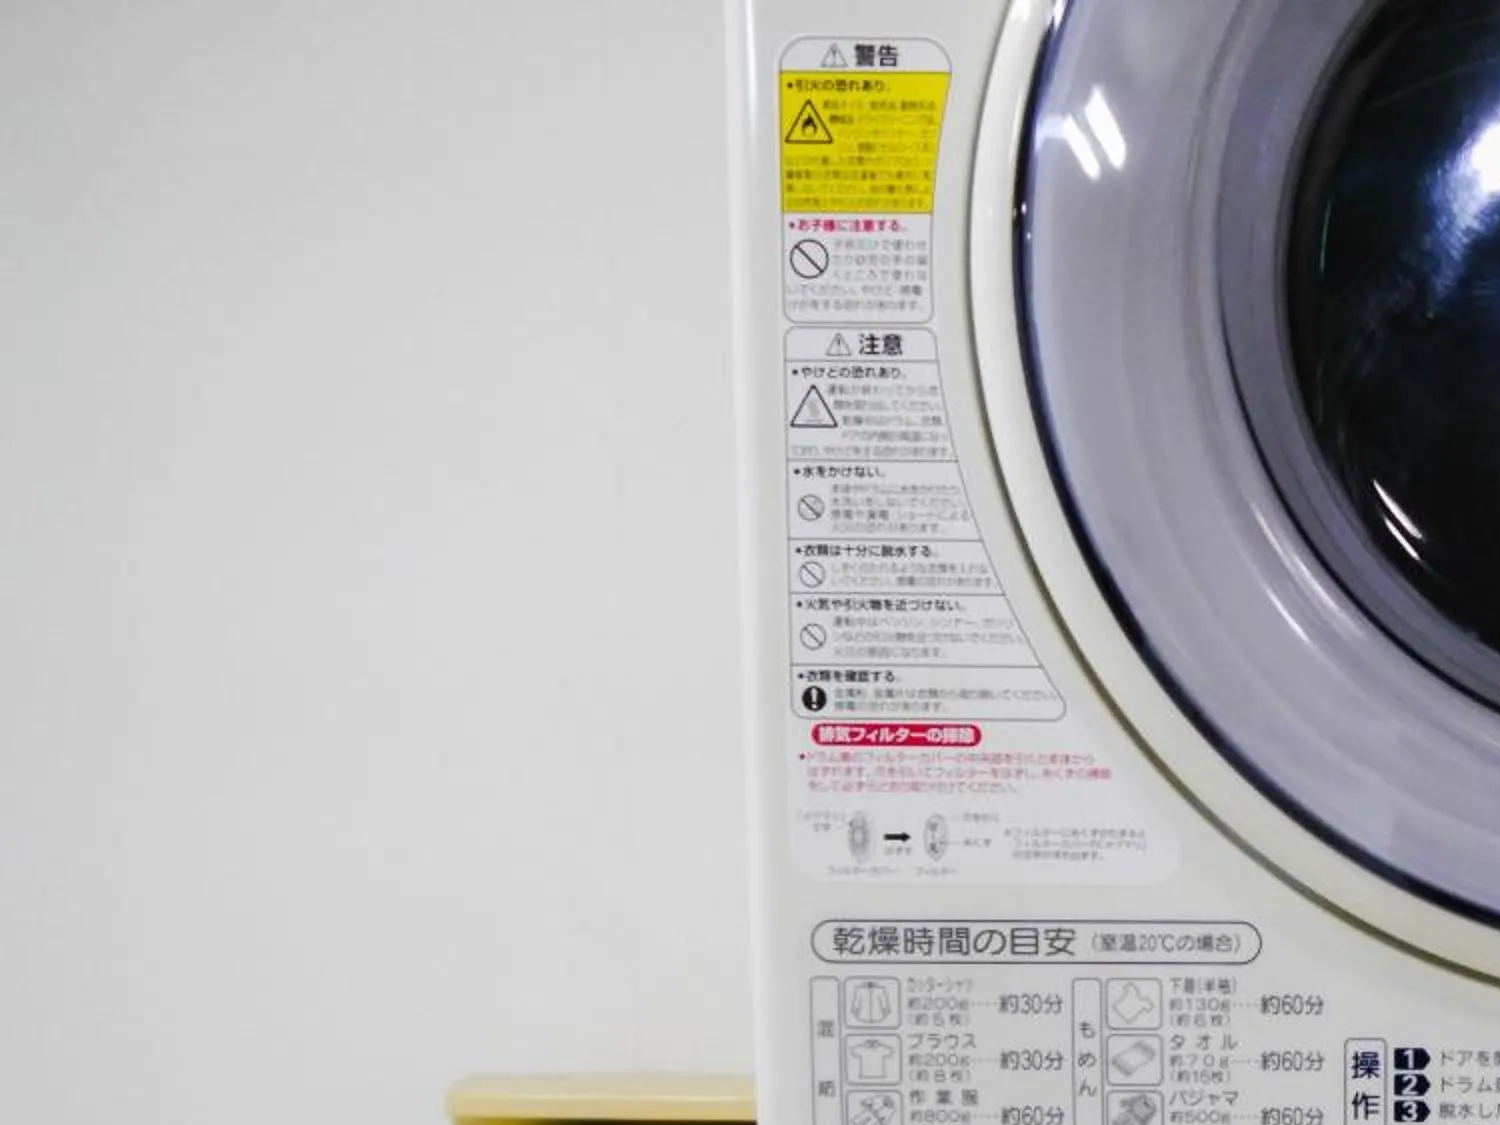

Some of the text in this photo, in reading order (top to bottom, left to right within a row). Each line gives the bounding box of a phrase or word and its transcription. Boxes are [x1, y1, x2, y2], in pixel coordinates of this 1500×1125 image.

[854, 44, 898, 67] 警告
[859, 334, 903, 355] 注意
[801, 366, 906, 380] やけどの恐れあり。
[802, 466, 885, 478] 水をかけない。
[804, 544, 939, 558] 衣類は十分に脱水する。
[805, 598, 966, 612] 火気や引火物を近づけない。
[833, 926, 1076, 957] 乾燥時間の目安
[1000, 993, 1063, 1014] 約30分
[1261, 994, 1324, 1016] 約60分
[907, 1034, 976, 1049] ブラウス
[1000, 1050, 1064, 1070] 約30分
[1261, 1051, 1325, 1071] 約60分
